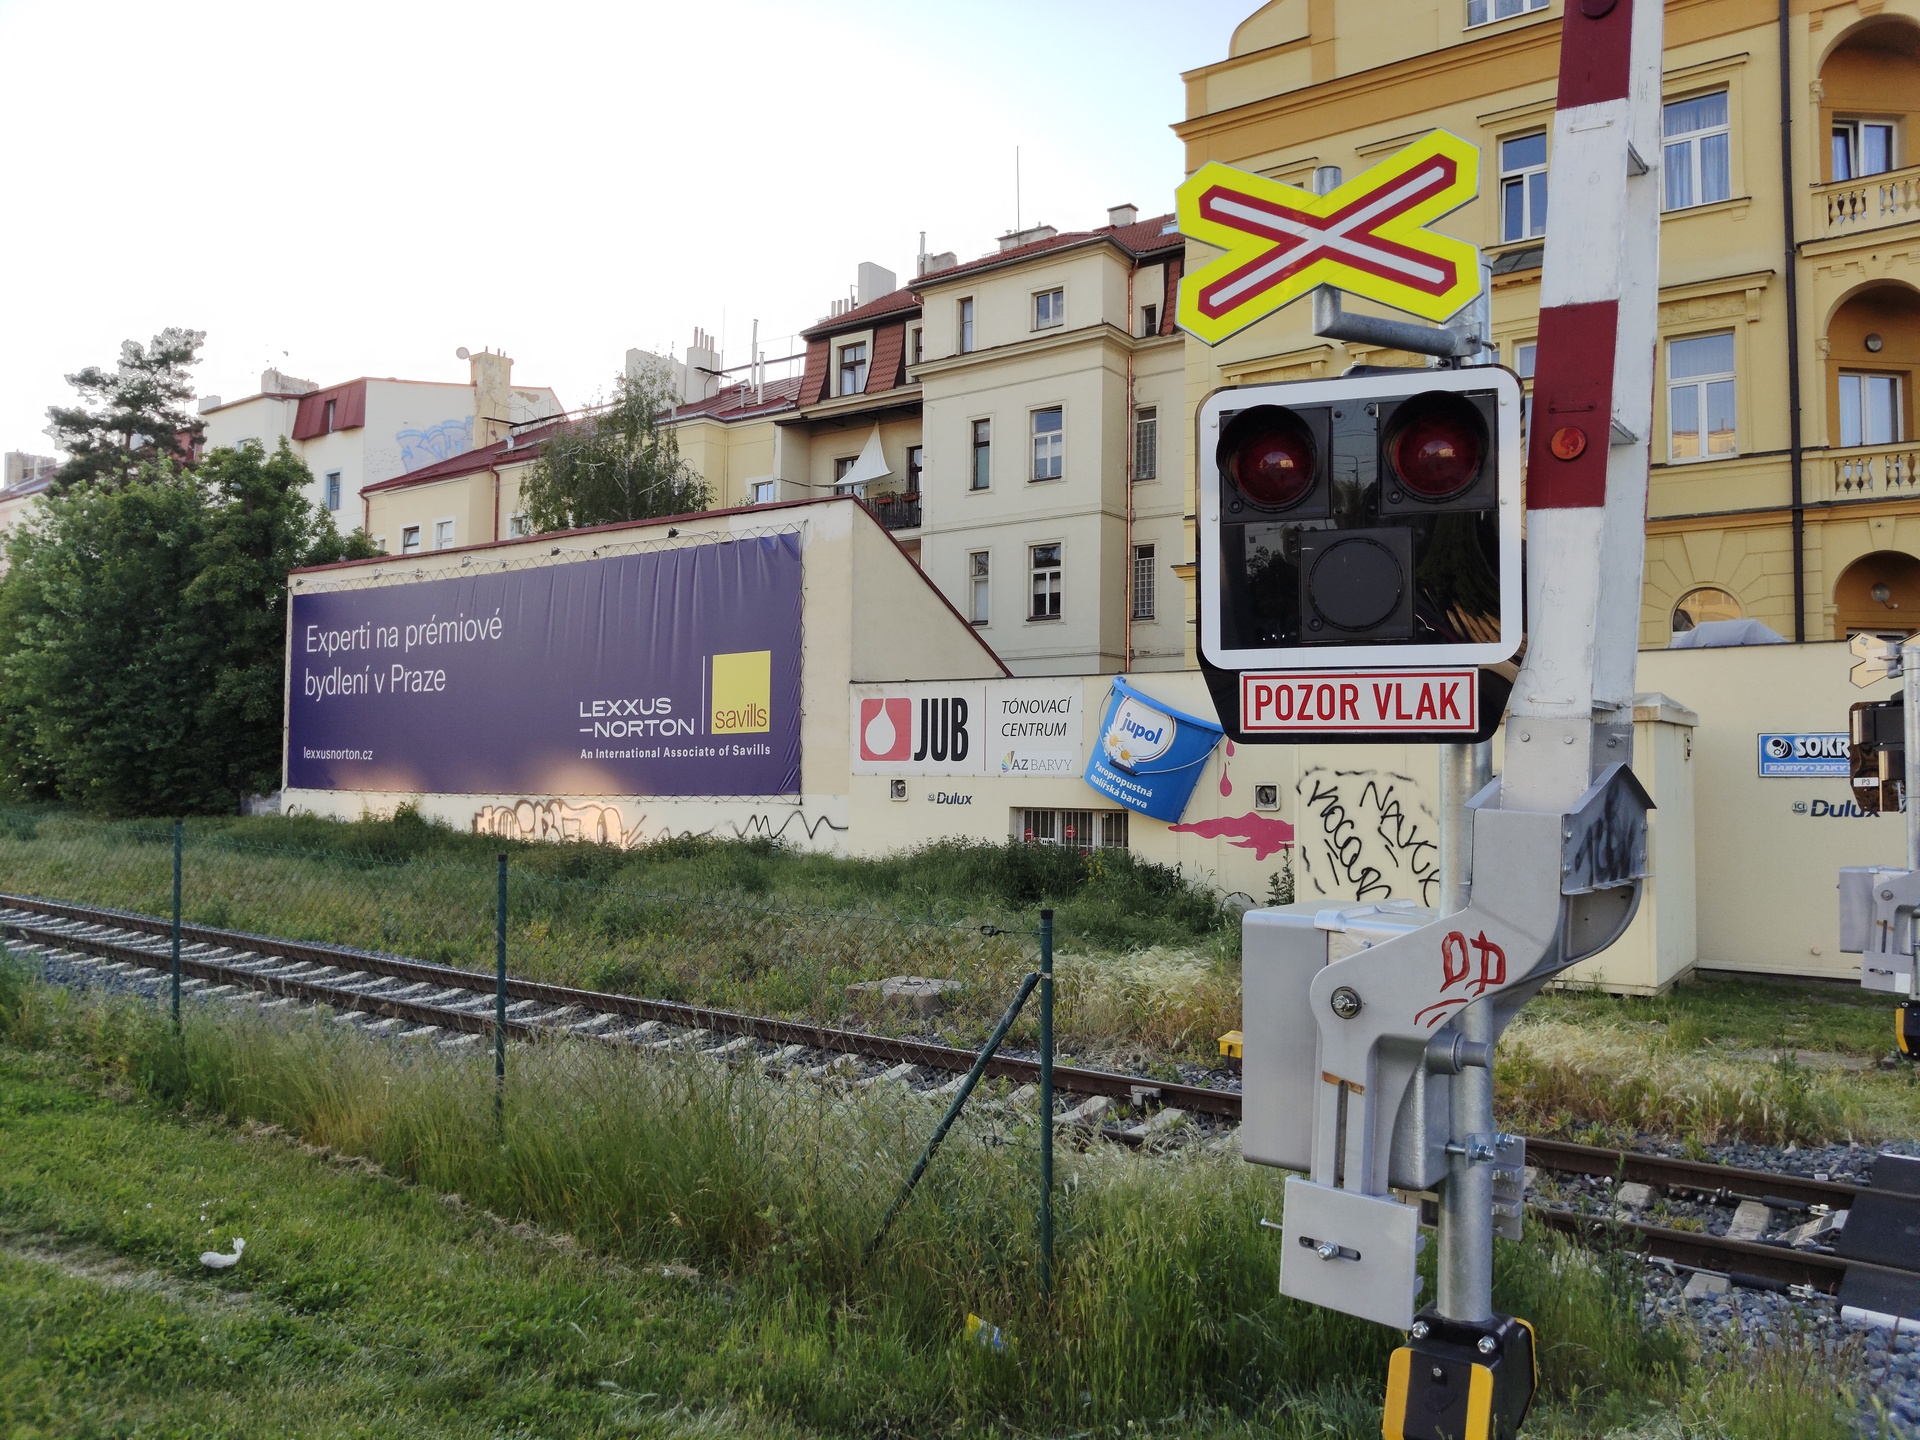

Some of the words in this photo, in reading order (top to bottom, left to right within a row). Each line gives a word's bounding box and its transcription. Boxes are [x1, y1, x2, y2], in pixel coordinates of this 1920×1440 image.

[306, 622, 370, 657] Experti
[376, 626, 399, 648] na
[405, 608, 502, 653] prémiové
[305, 665, 370, 702] bydlení
[374, 673, 385, 693] v
[391, 664, 446, 693] Praze
[579, 697, 672, 718] LEXXUS
[1002, 695, 1072, 714] TÓNOVACÍ
[1255, 683, 1360, 721] POZOR
[1372, 682, 1461, 720] VLAK
[714, 703, 767, 729] savills
[913, 697, 969, 762] JUB
[1001, 722, 1067, 737] CENTRUM
[1120, 711, 1164, 745] jupol
[303, 746, 373, 760] lexxusnorton.cz
[580, 749, 593, 759] An
[595, 747, 661, 759] International
[663, 746, 716, 758] Associate
[718, 744, 730, 756] of
[732, 743, 771, 756] Savills
[1768, 763, 1808, 772] BARVY
[1094, 760, 1153, 798] Paropropustná
[936, 792, 973, 805] Dulux
[1120, 790, 1148, 809] barva
